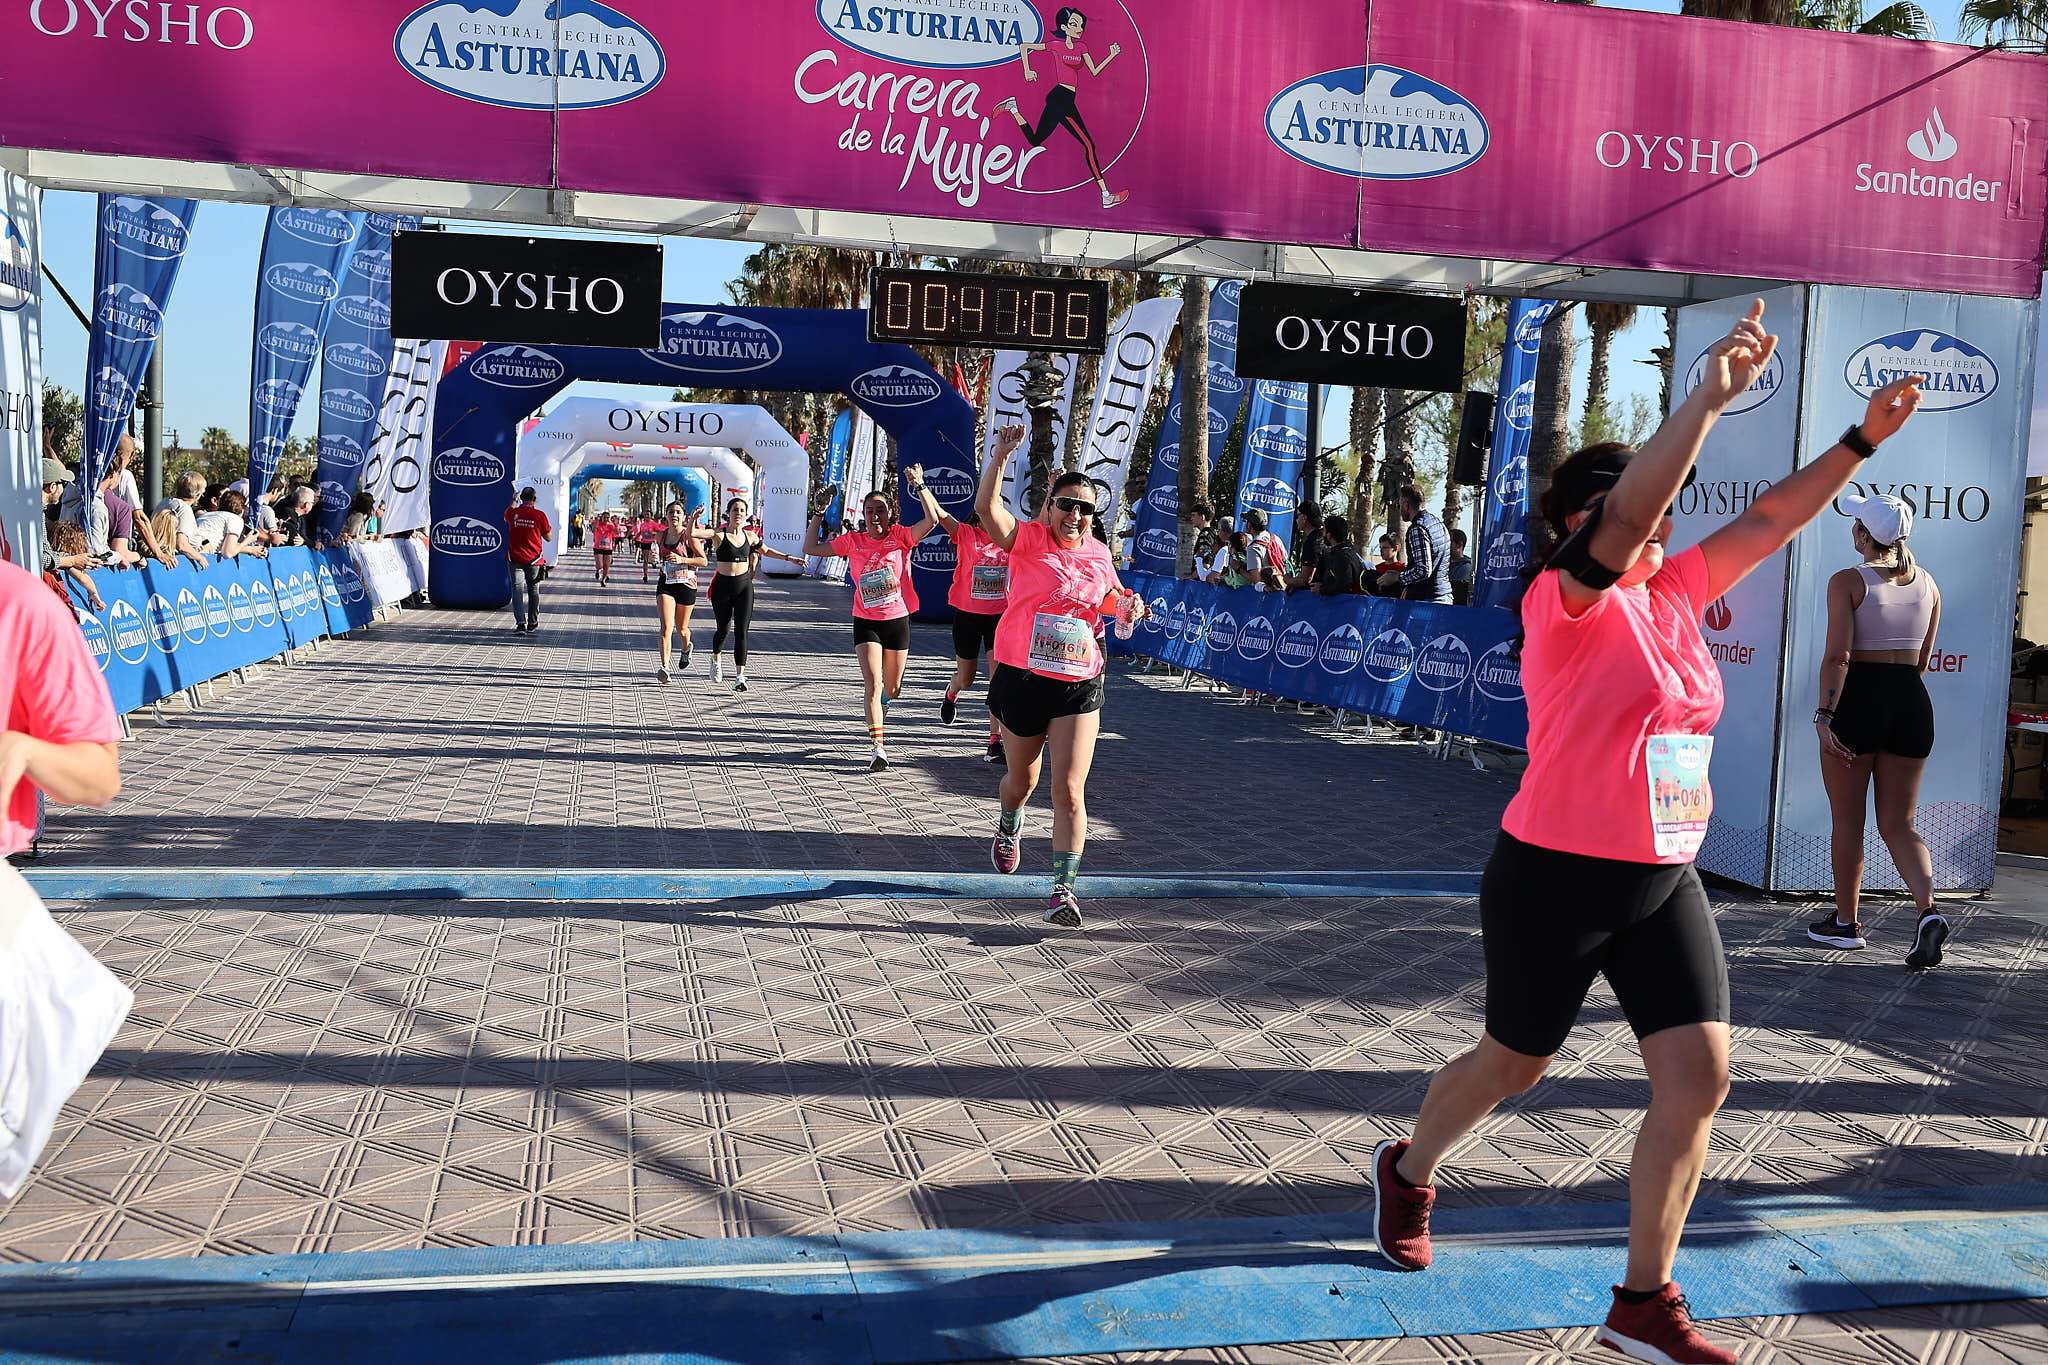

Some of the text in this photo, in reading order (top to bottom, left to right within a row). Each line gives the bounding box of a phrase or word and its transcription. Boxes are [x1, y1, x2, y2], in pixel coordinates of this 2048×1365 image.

[950, 0, 1020, 15] LECHERA
[30, 0, 254, 50] OYSHO
[459, 22, 637, 47] CENTRAL LECHERA
[834, 0, 1024, 46] ASTURIANA
[416, 22, 645, 84] ASTURIANA
[793, 49, 980, 120] Carrera
[1319, 100, 1466, 122] CENTRAL LECHERA
[1282, 99, 1472, 155] ASTURIANA
[838, 113, 1047, 208] de la Mujer
[1595, 131, 1760, 178] OYSHO
[1855, 163, 2001, 203] Santander
[270, 269, 331, 297] ASTURIAA
[437, 268, 624, 315] OYSHO
[886, 281, 1090, 340] 00:41:06
[670, 327, 767, 340] CENTRAL LECHERA
[1276, 316, 1434, 359] OYSHO
[329, 347, 381, 373] ASTURIANA
[475, 360, 557, 379] ASTURIANA
[1880, 355, 1984, 371] CENTRAL LECHERA
[859, 382, 935, 396] ASTURIANA
[608, 408, 723, 435] OYSHO
[538, 431, 573, 440] OYSHO
[755, 439, 789, 448] OYSHO
[436, 460, 500, 478] ASTURIANA
[771, 486, 803, 496] OYSHO
[434, 529, 497, 547] ASTURIANA
[769, 532, 801, 541] OYSHO
[1277, 636, 1315, 658] ASTURIANA
[1320, 641, 1359, 664] ASTURIANA
[1366, 647, 1410, 671] ASTURIANA
[1418, 654, 1465, 679] ASTURIANA
